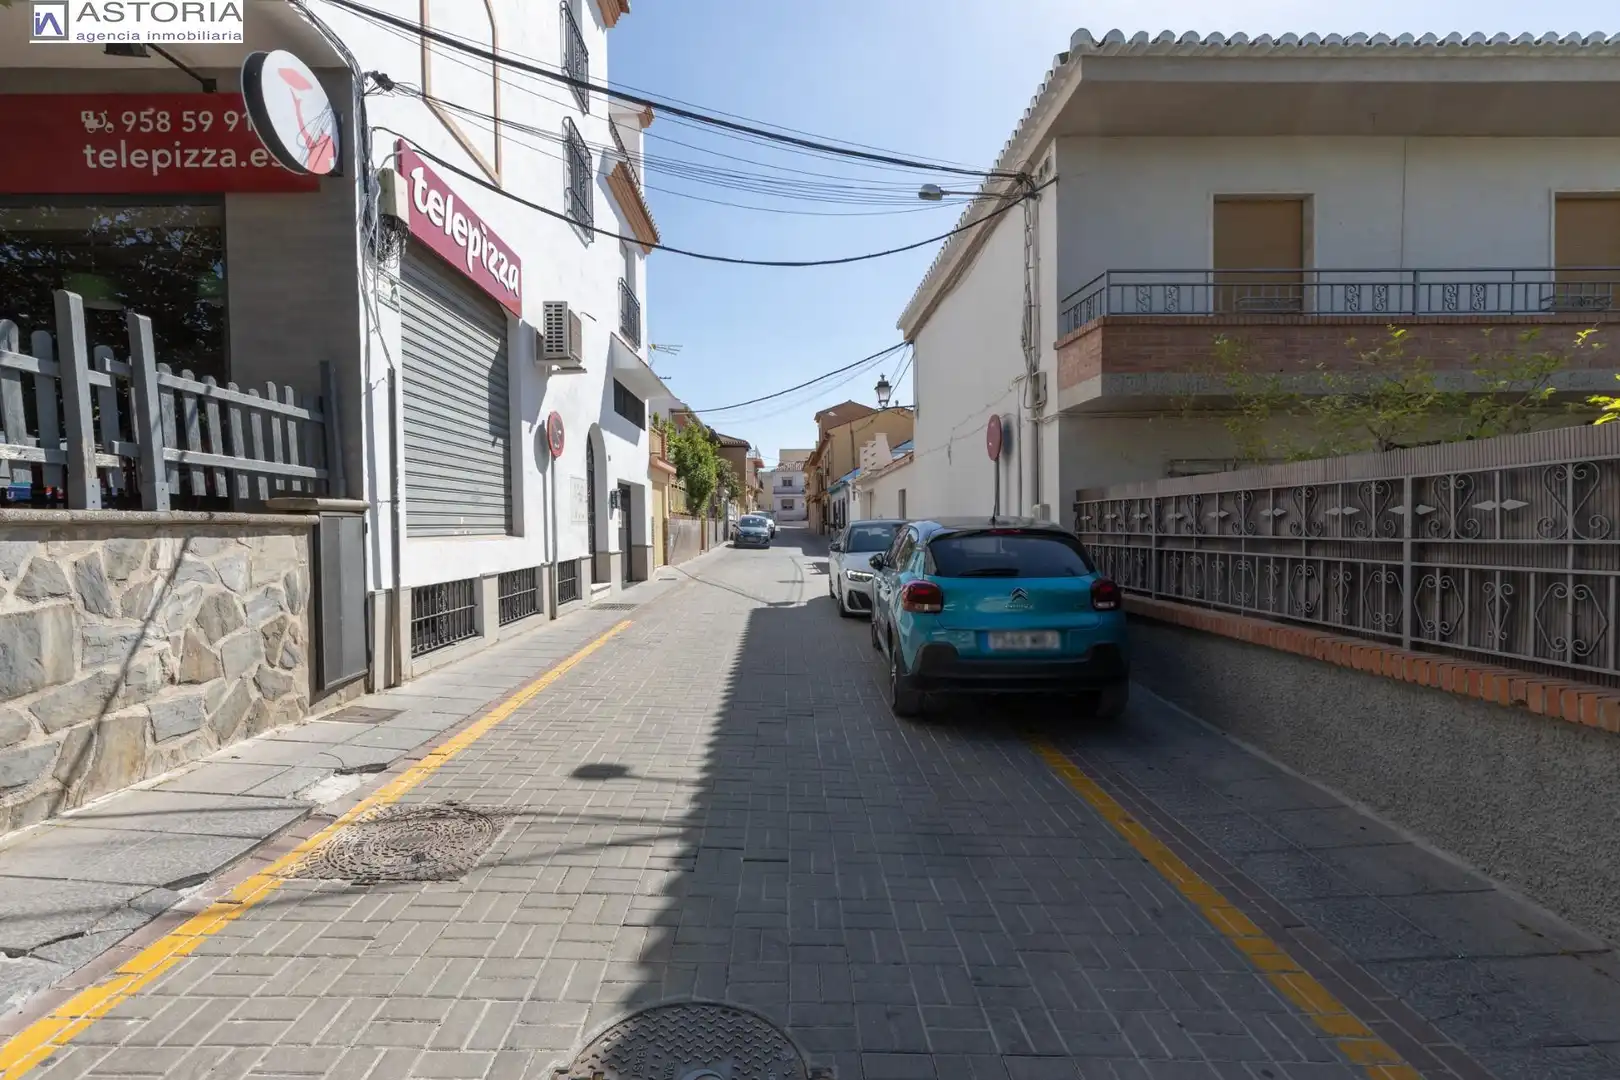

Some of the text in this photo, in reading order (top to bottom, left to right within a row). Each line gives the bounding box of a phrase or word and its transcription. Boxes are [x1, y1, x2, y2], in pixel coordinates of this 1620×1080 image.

[121, 110, 171, 132] 958
[182, 110, 214, 132] 59
[410, 166, 519, 298] telepizza
